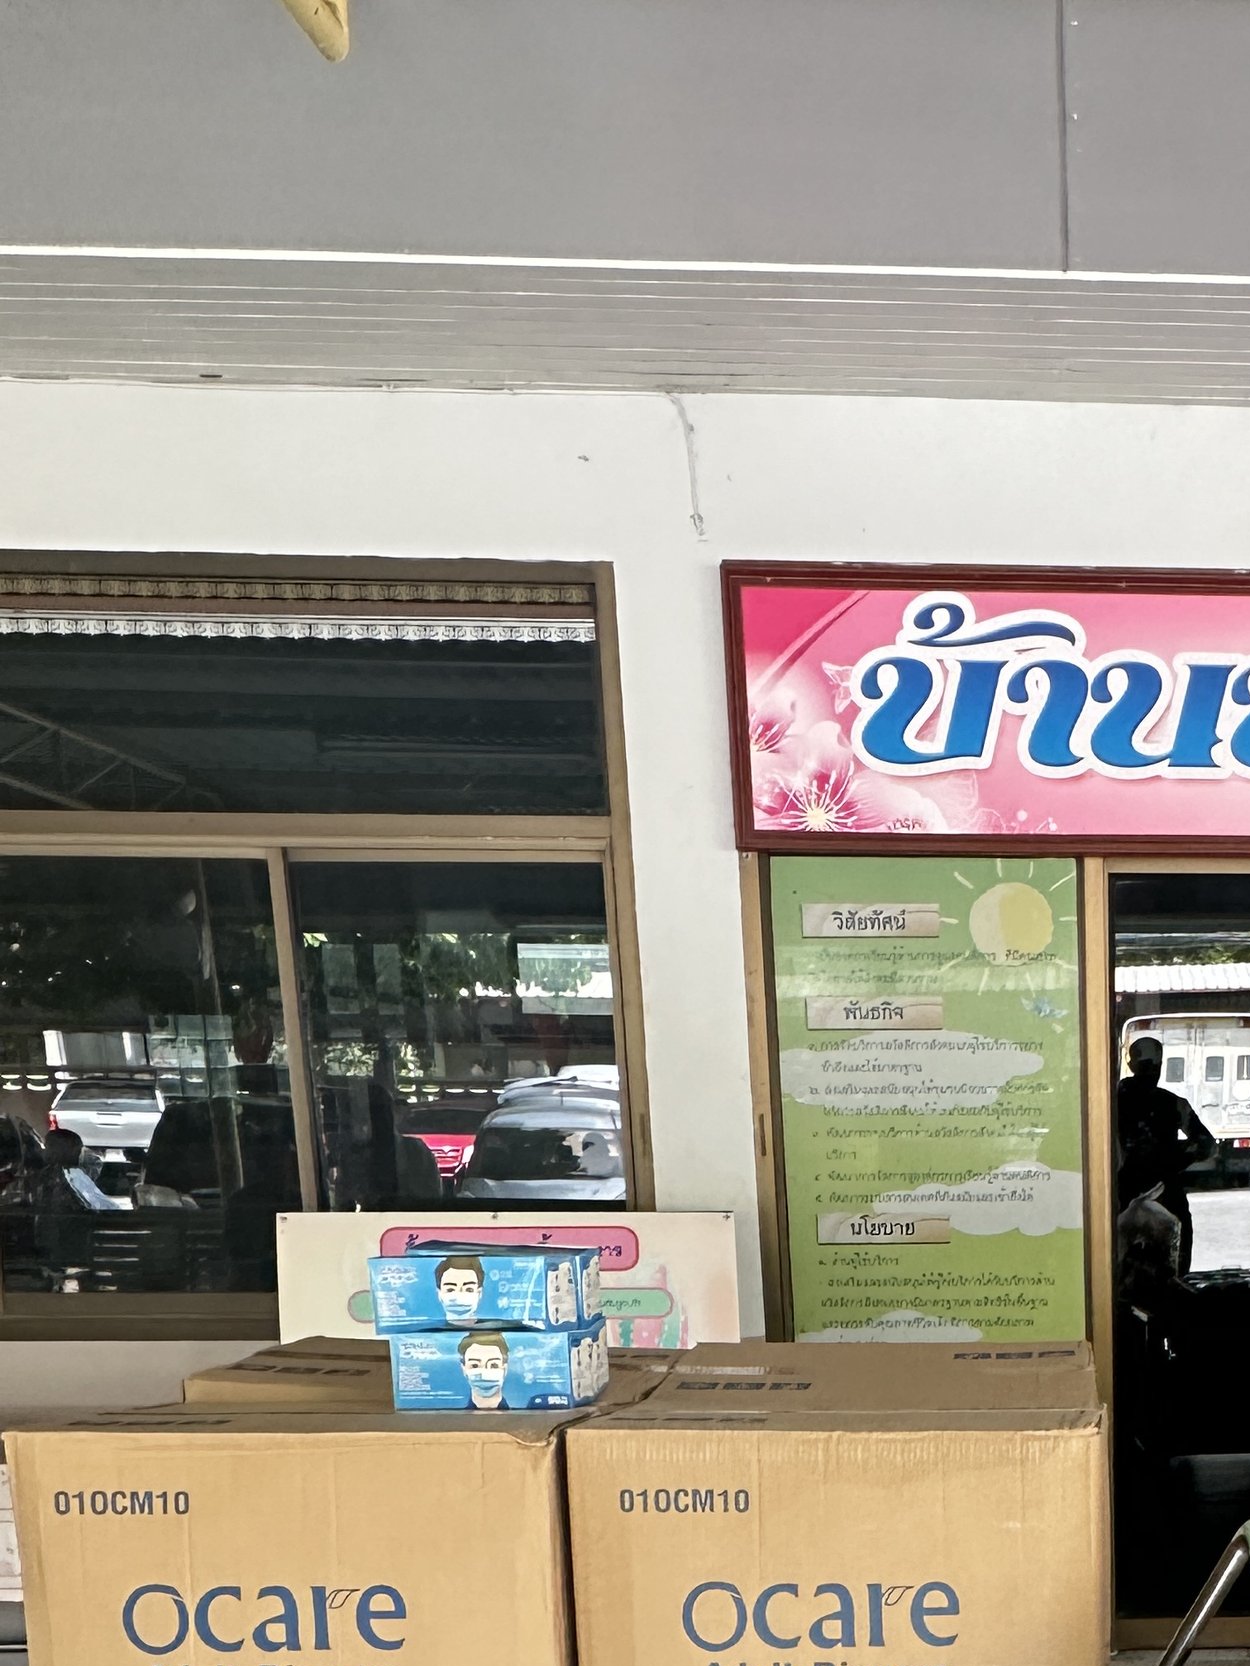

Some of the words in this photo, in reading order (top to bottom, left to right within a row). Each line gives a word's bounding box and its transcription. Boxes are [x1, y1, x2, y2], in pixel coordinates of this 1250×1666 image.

[832, 909, 906, 931] วิสัยทัศน์
[844, 1000, 904, 1020] พันธกิจ
[851, 1215, 915, 1236] นโยบาย
